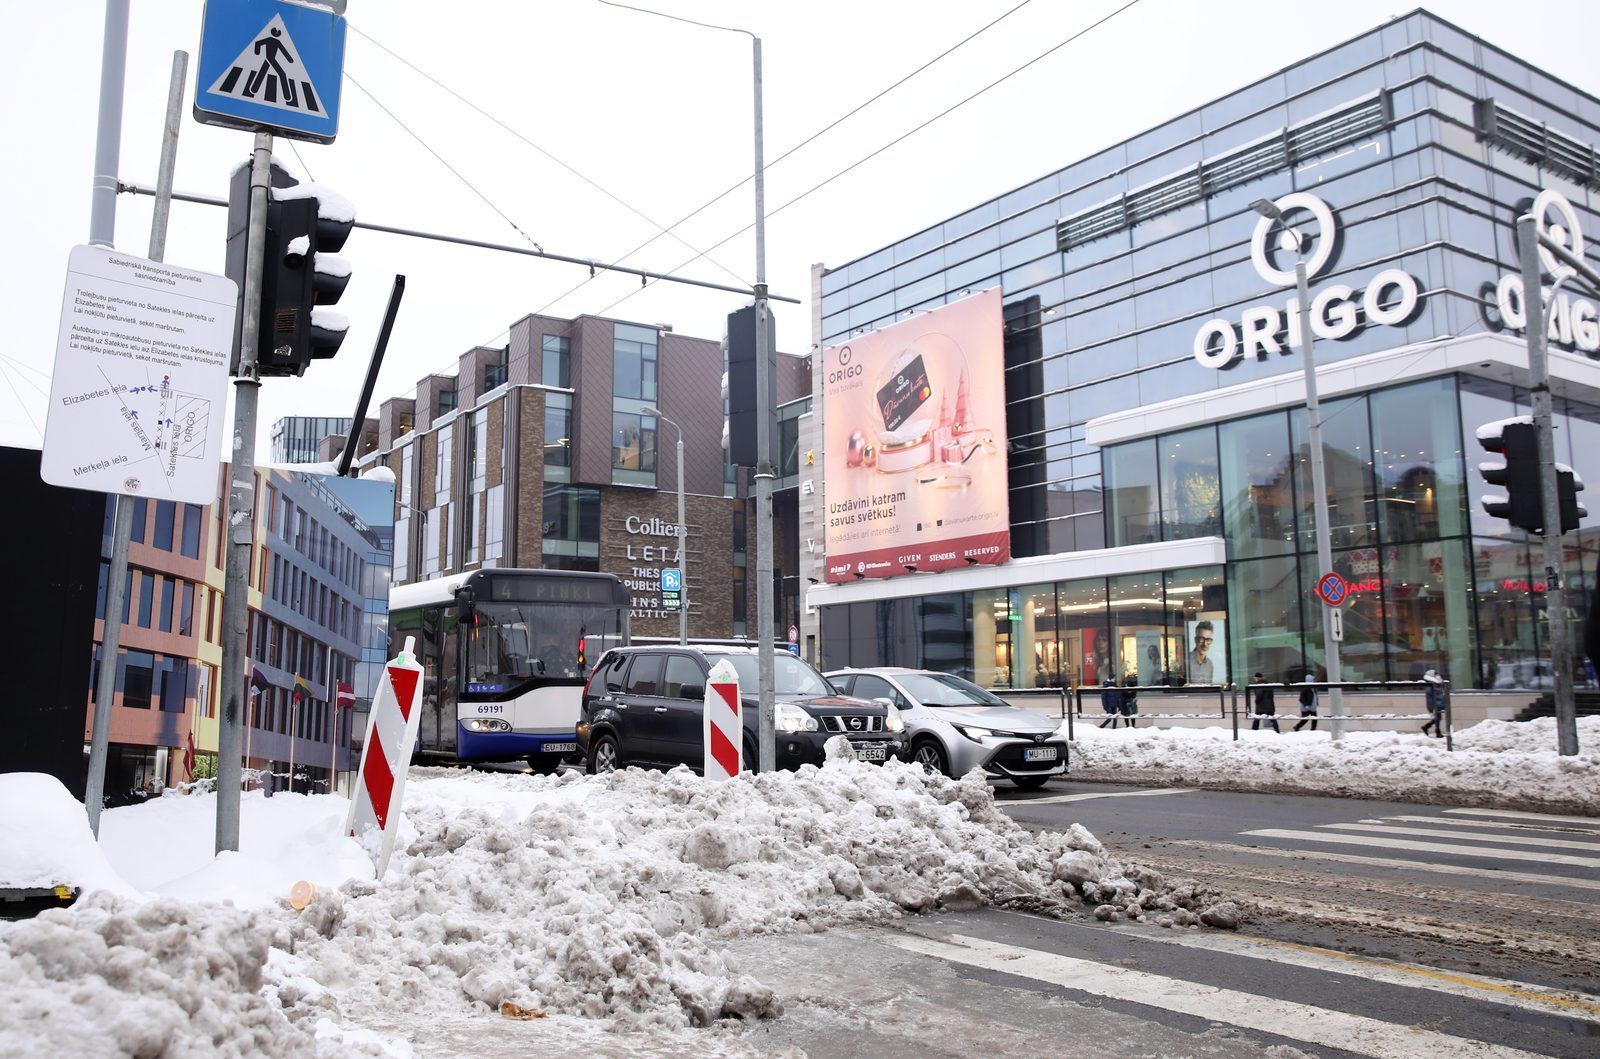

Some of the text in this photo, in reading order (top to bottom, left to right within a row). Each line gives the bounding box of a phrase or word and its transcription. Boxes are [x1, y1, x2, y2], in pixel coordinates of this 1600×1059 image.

[108, 257, 202, 283] Sabiedriskā transporta pieturvietas
[134, 273, 176, 286] sasniedzamība
[75, 297, 105, 309] Elizabetes
[77, 289, 107, 301] Trolejbusu
[107, 296, 137, 307] pieturvieta
[147, 303, 171, 314] Satekles
[172, 309, 185, 317] ielas
[73, 306, 83, 314] Lai
[139, 319, 154, 328] sekot
[1194, 268, 1417, 369] ORIGO
[69, 341, 79, 349] Lai
[135, 353, 151, 362] sekot
[72, 324, 100, 335] Autobusu
[110, 331, 151, 345] mikroautobusu
[152, 340, 181, 350] pieturvieta
[190, 346, 213, 356] Satekles
[214, 351, 227, 359] ielas
[104, 338, 129, 349] Satekles
[130, 344, 140, 352] ielu
[150, 347, 179, 358] Elizabetes
[180, 353, 193, 361] ielas
[829, 364, 863, 384] ORIGO
[62, 383, 127, 407] Elizabetes iela
[120, 406, 151, 452] Marijas iela
[184, 411, 196, 443] ORIGO
[112, 454, 128, 464] iela
[167, 424, 182, 477] Satekles iela
[830, 491, 906, 514] Uzdāvini katram
[830, 505, 896, 528] savus svētkus!
[898, 554, 922, 564] GIVEN
[929, 551, 956, 562] STENDERS
[964, 546, 1000, 557] RESERVED
[501, 581, 512, 600] 4
[477, 705, 504, 714] 69191
[855, 749, 885, 760] T-6542
